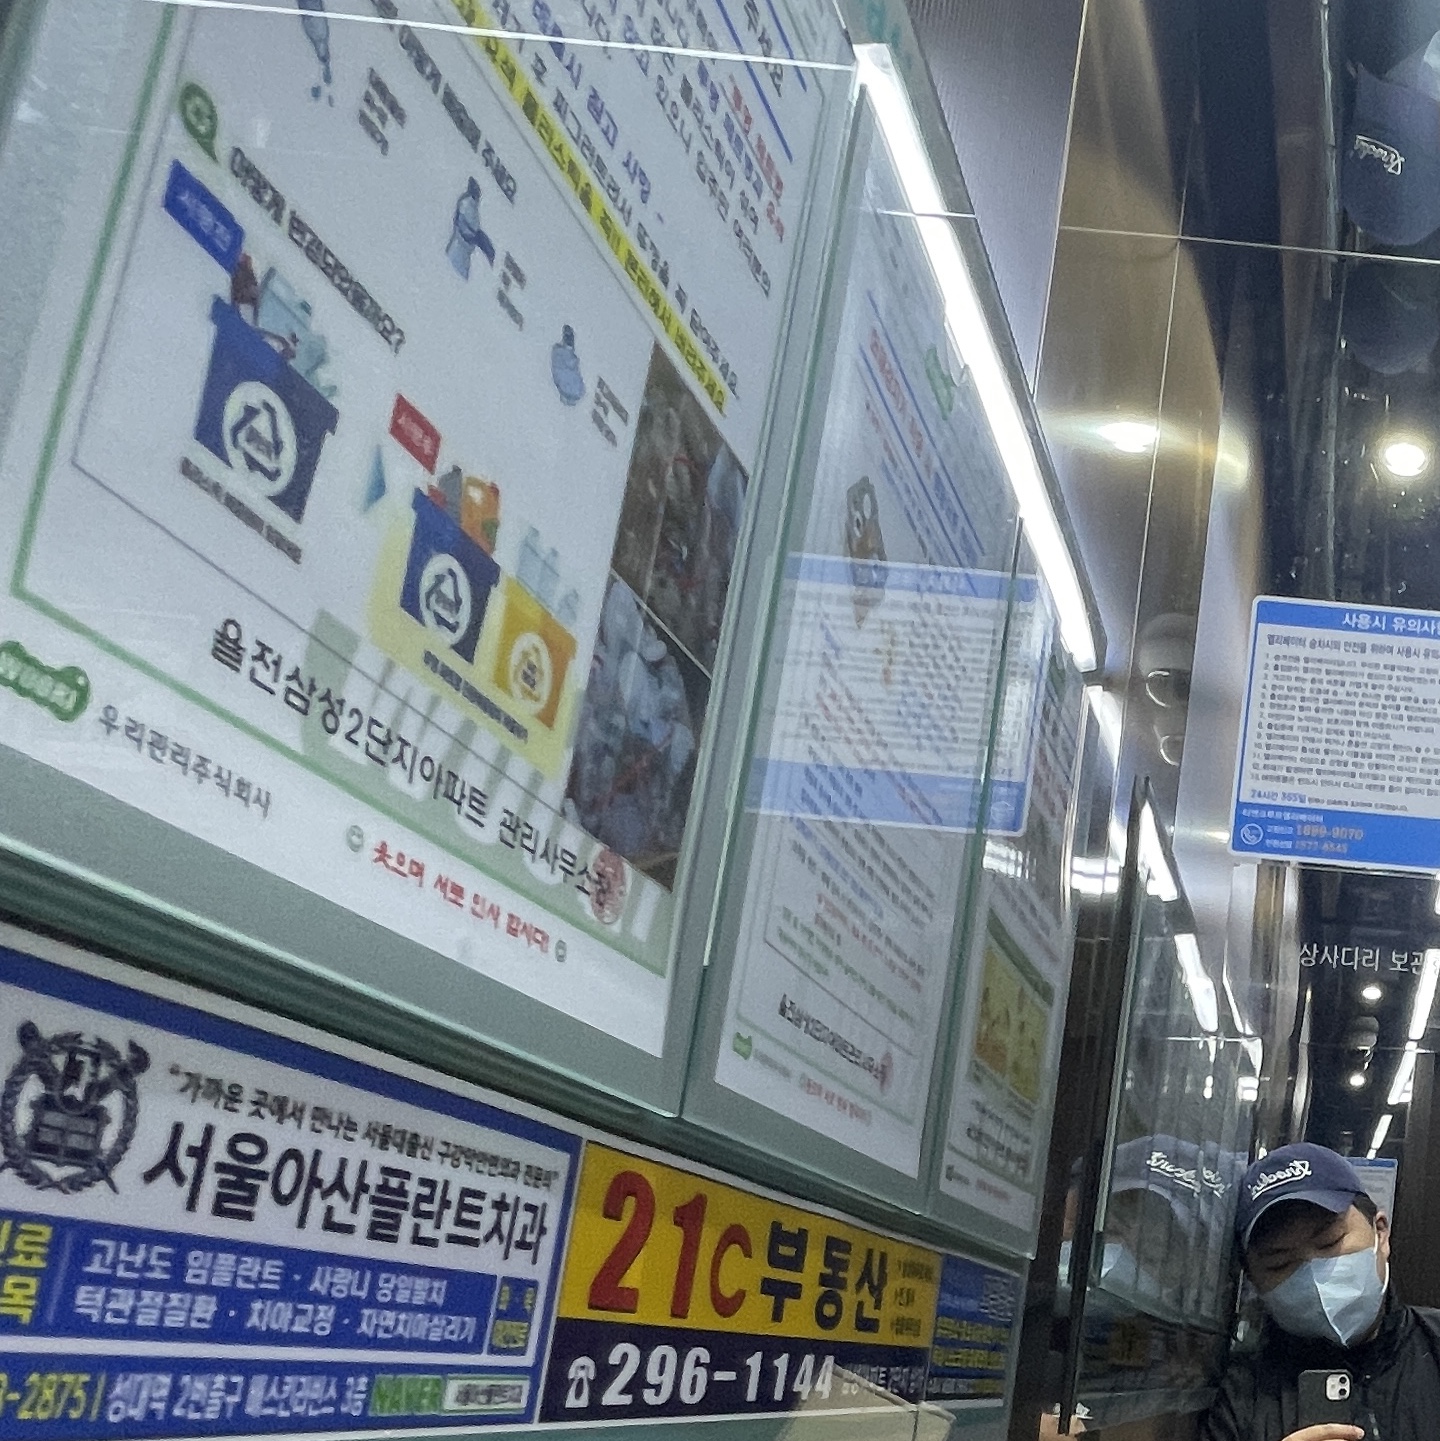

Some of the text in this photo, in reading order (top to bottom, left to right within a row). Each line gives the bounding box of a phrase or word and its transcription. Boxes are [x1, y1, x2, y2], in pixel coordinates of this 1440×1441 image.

[1342, 612, 1387, 632] 사용시
[210, 617, 490, 829] 율전삼성2단지아파트
[98, 704, 272, 819] 우리관리주식회사
[372, 839, 550, 954] 웃으며 서로 인사 합시다
[247, 1087, 306, 1132] 곳에서
[310, 1104, 359, 1143] 만나는
[143, 1119, 548, 1266] 서울아산플란트치과
[0, 1217, 53, 1269] 료
[82, 1238, 448, 1308] 고난도 임플란트 사랑니 당일발치
[74, 1284, 218, 1330] 턱관절질환
[246, 1298, 336, 1337] 치아교정
[601, 1341, 835, 1406] 296-1144
